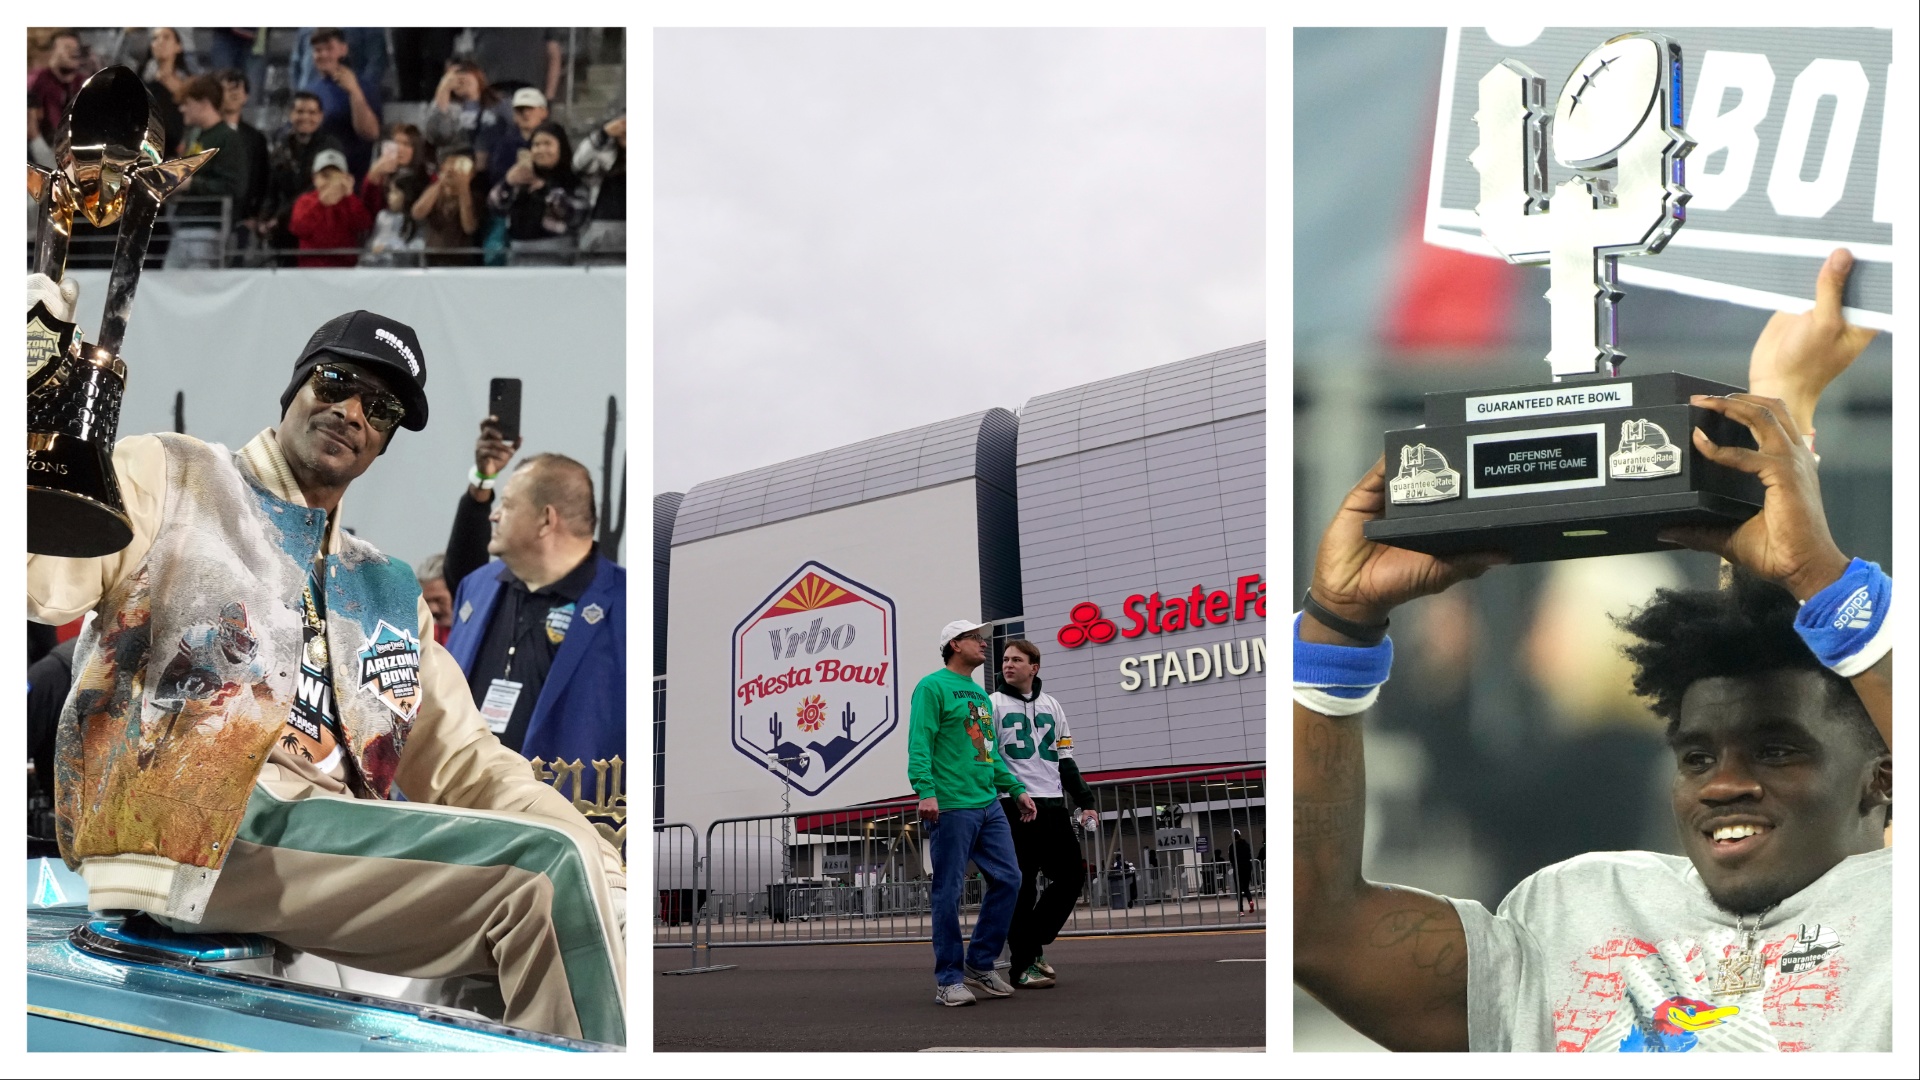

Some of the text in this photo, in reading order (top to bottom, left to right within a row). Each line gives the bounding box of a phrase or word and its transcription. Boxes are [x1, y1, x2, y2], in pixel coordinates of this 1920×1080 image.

[1477, 391, 1621, 414] GUARANTEED RATE BOWL
[1509, 448, 1562, 462] DEFENSIVE
[1613, 454, 1673, 468] guaranteed Rate
[1484, 458, 1588, 476] PLAYER OF THE GAME
[1625, 465, 1648, 473] BOWL
[1393, 478, 1452, 492] guaranteed Rate
[1406, 490, 1428, 498] BOWL
[1121, 584, 1230, 638] State
[1833, 591, 1869, 630] adidas
[768, 616, 856, 660] Vrbo
[366, 652, 419, 676] ARIZONA
[380, 668, 418, 688] BOWL
[737, 659, 889, 706] Fiesta Bowl
[1002, 712, 1058, 762] 32
[1157, 834, 1190, 847] AZSTA
[1782, 951, 1827, 966] guaranteed
[1794, 961, 1816, 971] BOWL
